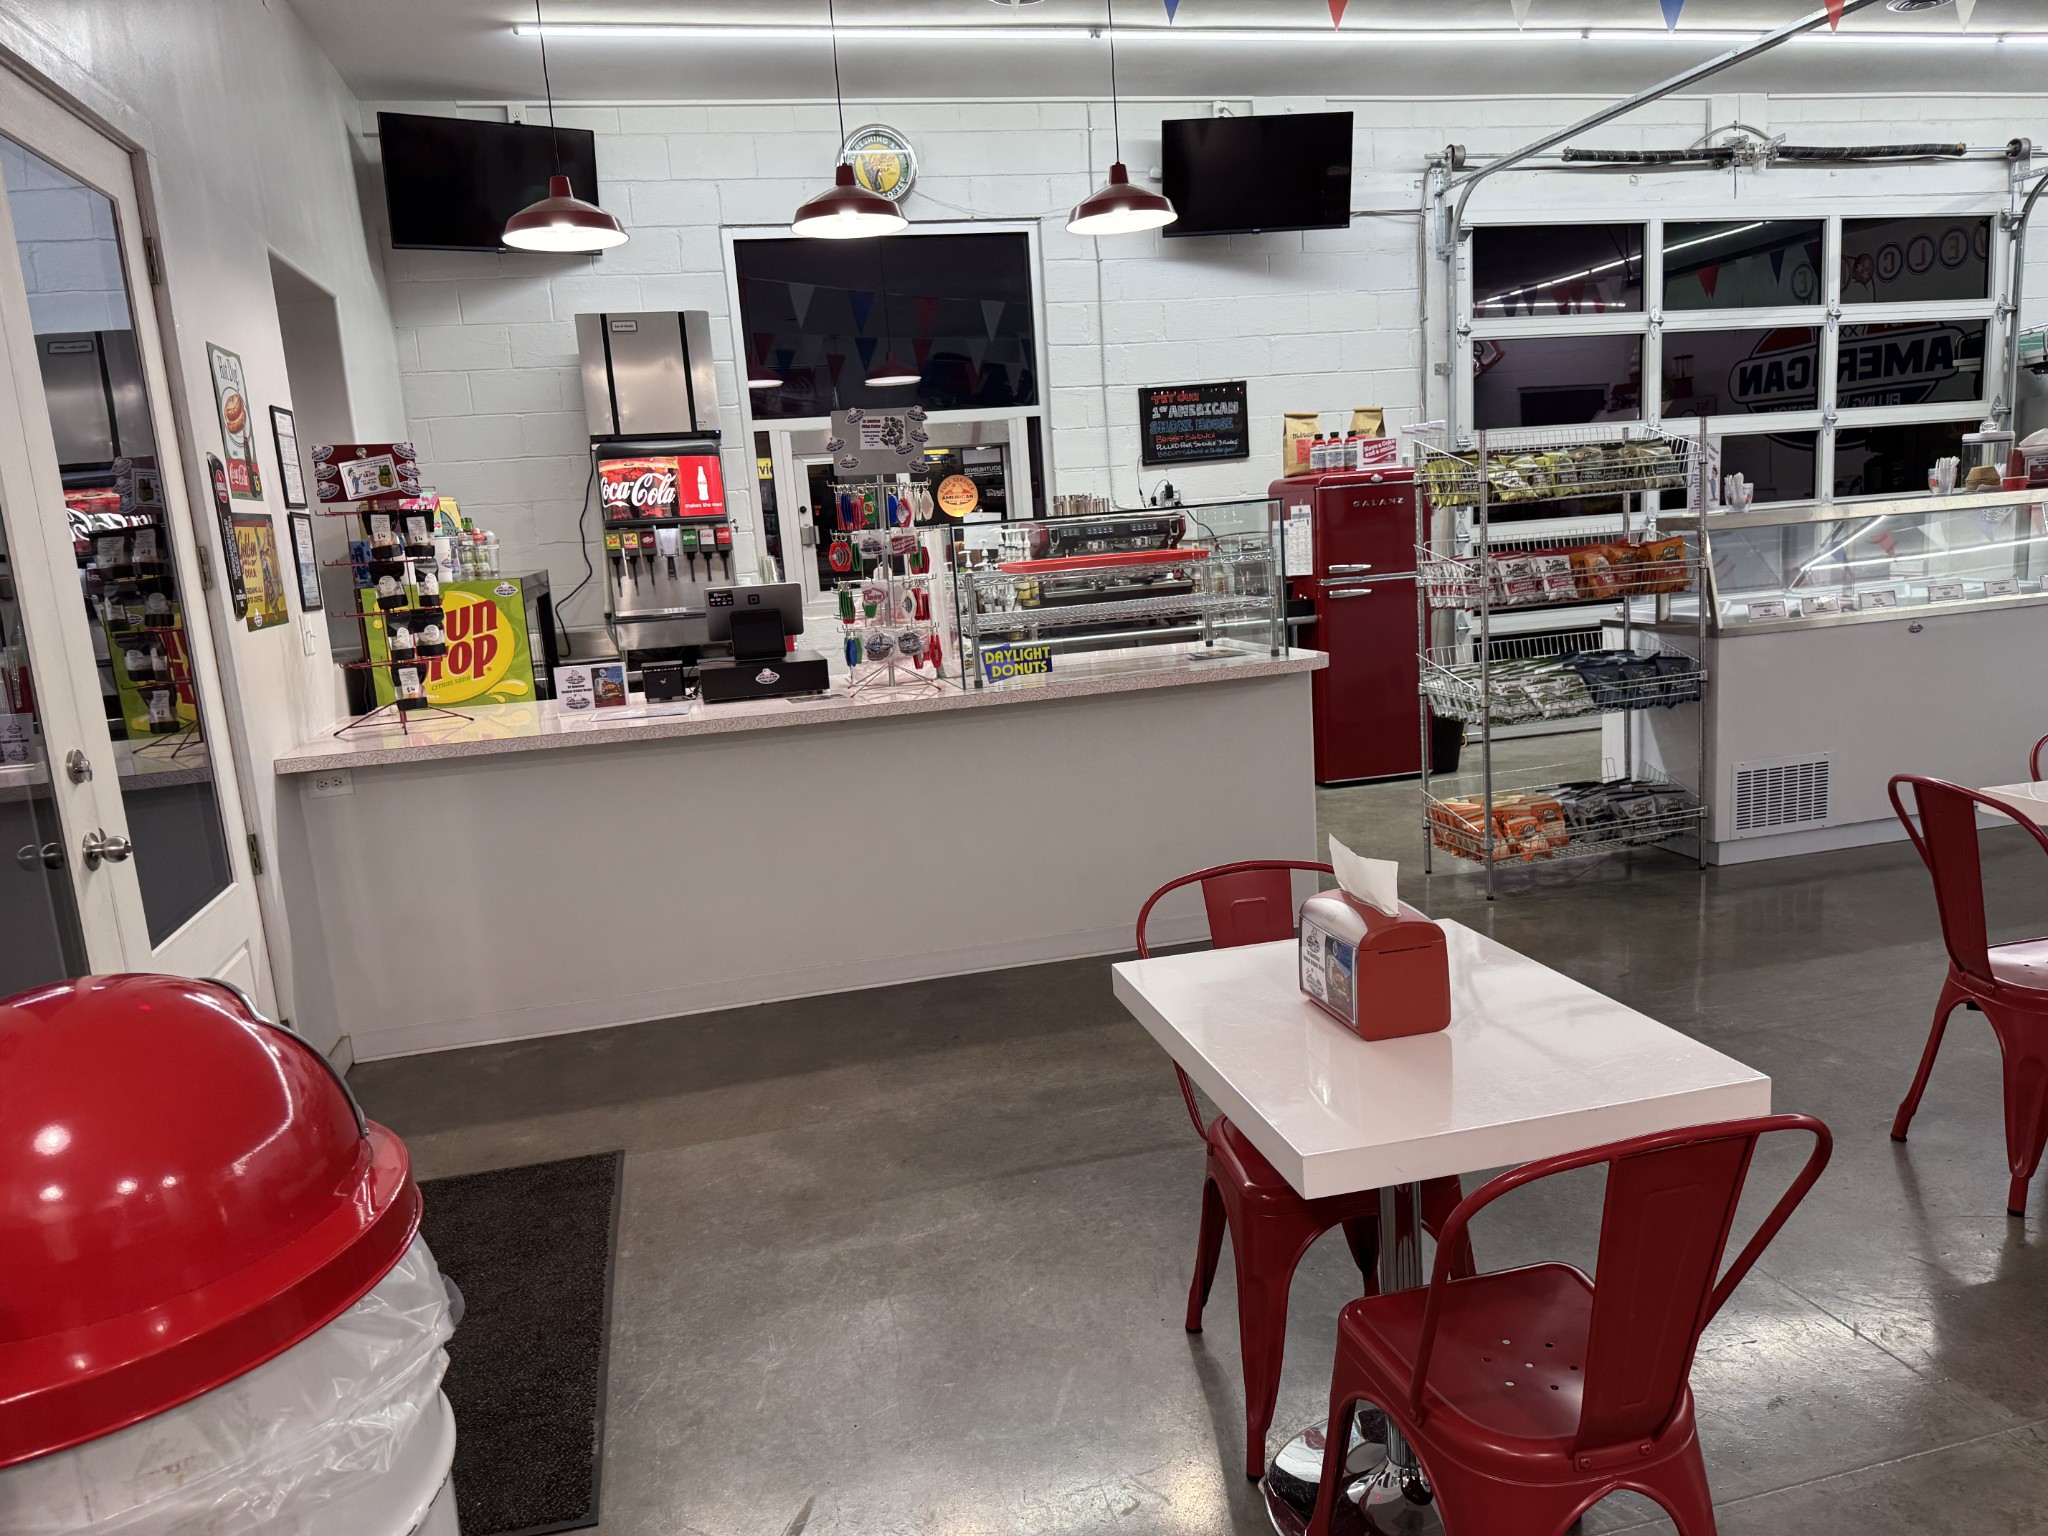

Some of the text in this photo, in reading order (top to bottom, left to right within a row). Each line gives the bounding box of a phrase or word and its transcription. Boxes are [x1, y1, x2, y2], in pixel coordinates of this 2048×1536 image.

[1168, 402, 1239, 418] AMERICAN
[1150, 417, 1234, 434] SMOKE HOUSE
[601, 473, 677, 508] Coca-Cola
[940, 477, 976, 494] FULL SERVICE
[1352, 497, 1404, 508] GALANZ
[985, 646, 1051, 664] DAYLIGHT
[992, 660, 1048, 678] DONUTS
